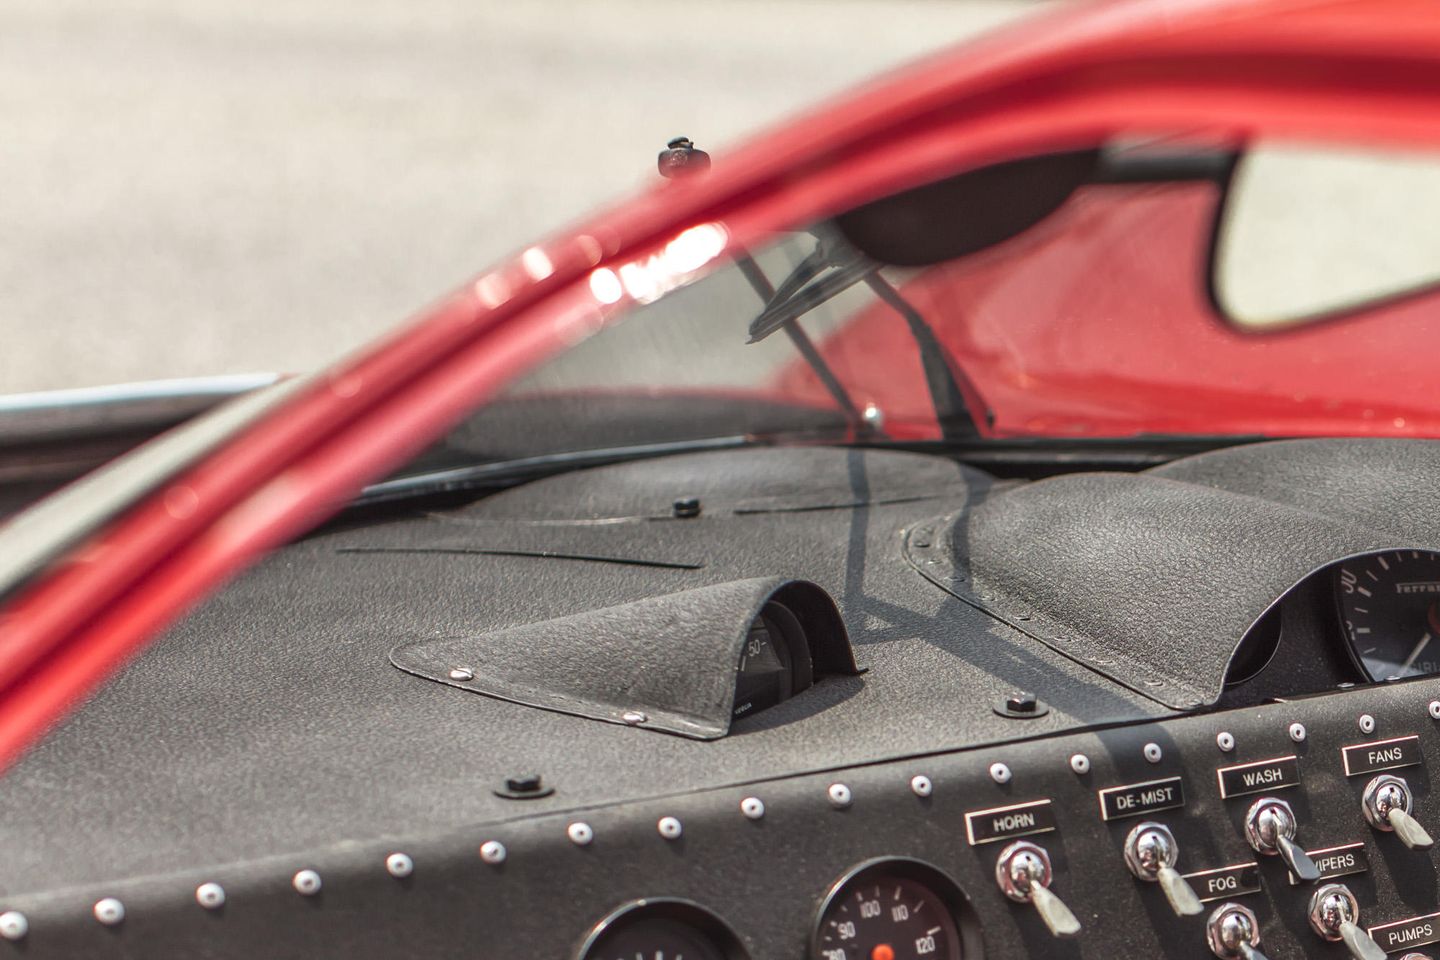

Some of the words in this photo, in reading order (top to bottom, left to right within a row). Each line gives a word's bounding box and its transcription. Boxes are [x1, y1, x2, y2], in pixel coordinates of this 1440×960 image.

[1367, 747, 1403, 765] FANS
[1242, 768, 1283, 787] WASH
[1115, 786, 1174, 810] DE-MIST
[993, 812, 1035, 833] HORN
[1315, 853, 1355, 872] IPERS
[1207, 874, 1237, 893] FOG
[860, 901, 881, 919] 100
[891, 904, 909, 923] 110
[837, 921, 856, 941] 90
[1388, 923, 1433, 945] PUMPS
[915, 936, 936, 955] 120
